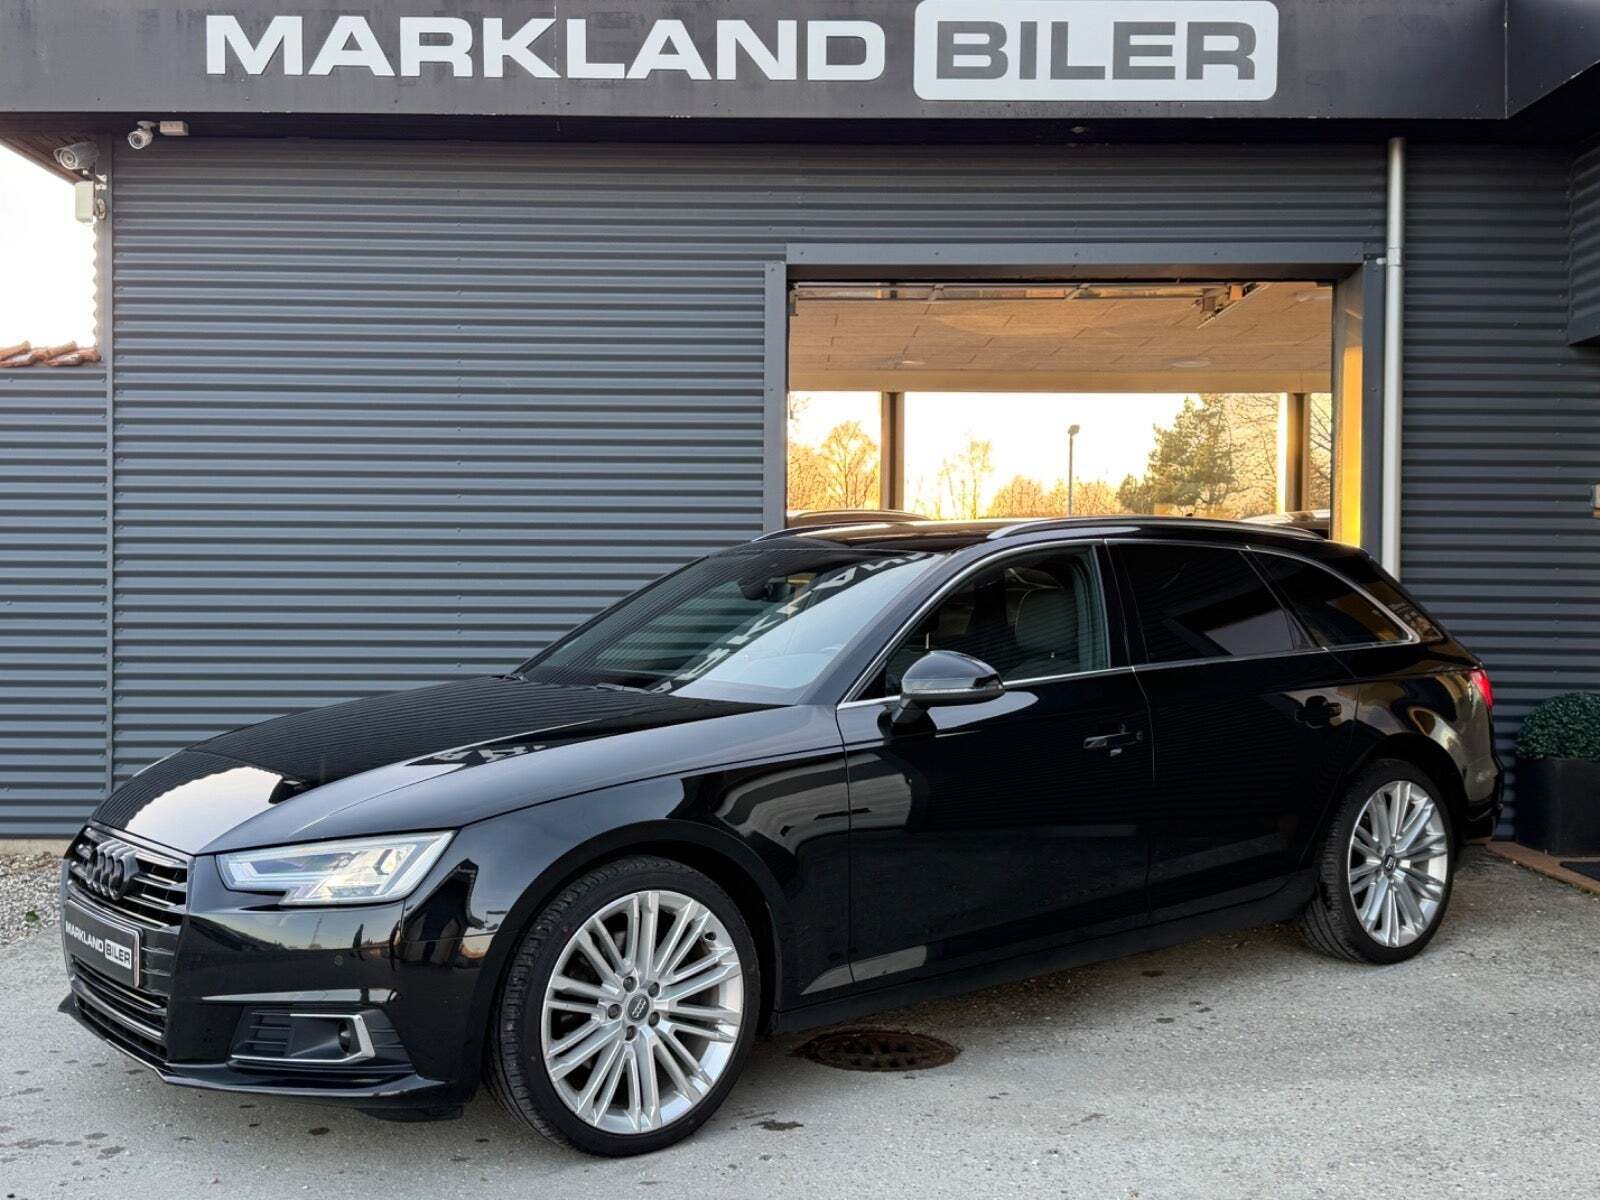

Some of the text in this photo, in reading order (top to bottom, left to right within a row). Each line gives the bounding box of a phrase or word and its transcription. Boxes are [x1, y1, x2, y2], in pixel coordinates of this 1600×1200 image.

[206, 15, 1256, 81] MARKLAND BILER
[65, 920, 131, 966] MARKLAND BILER
